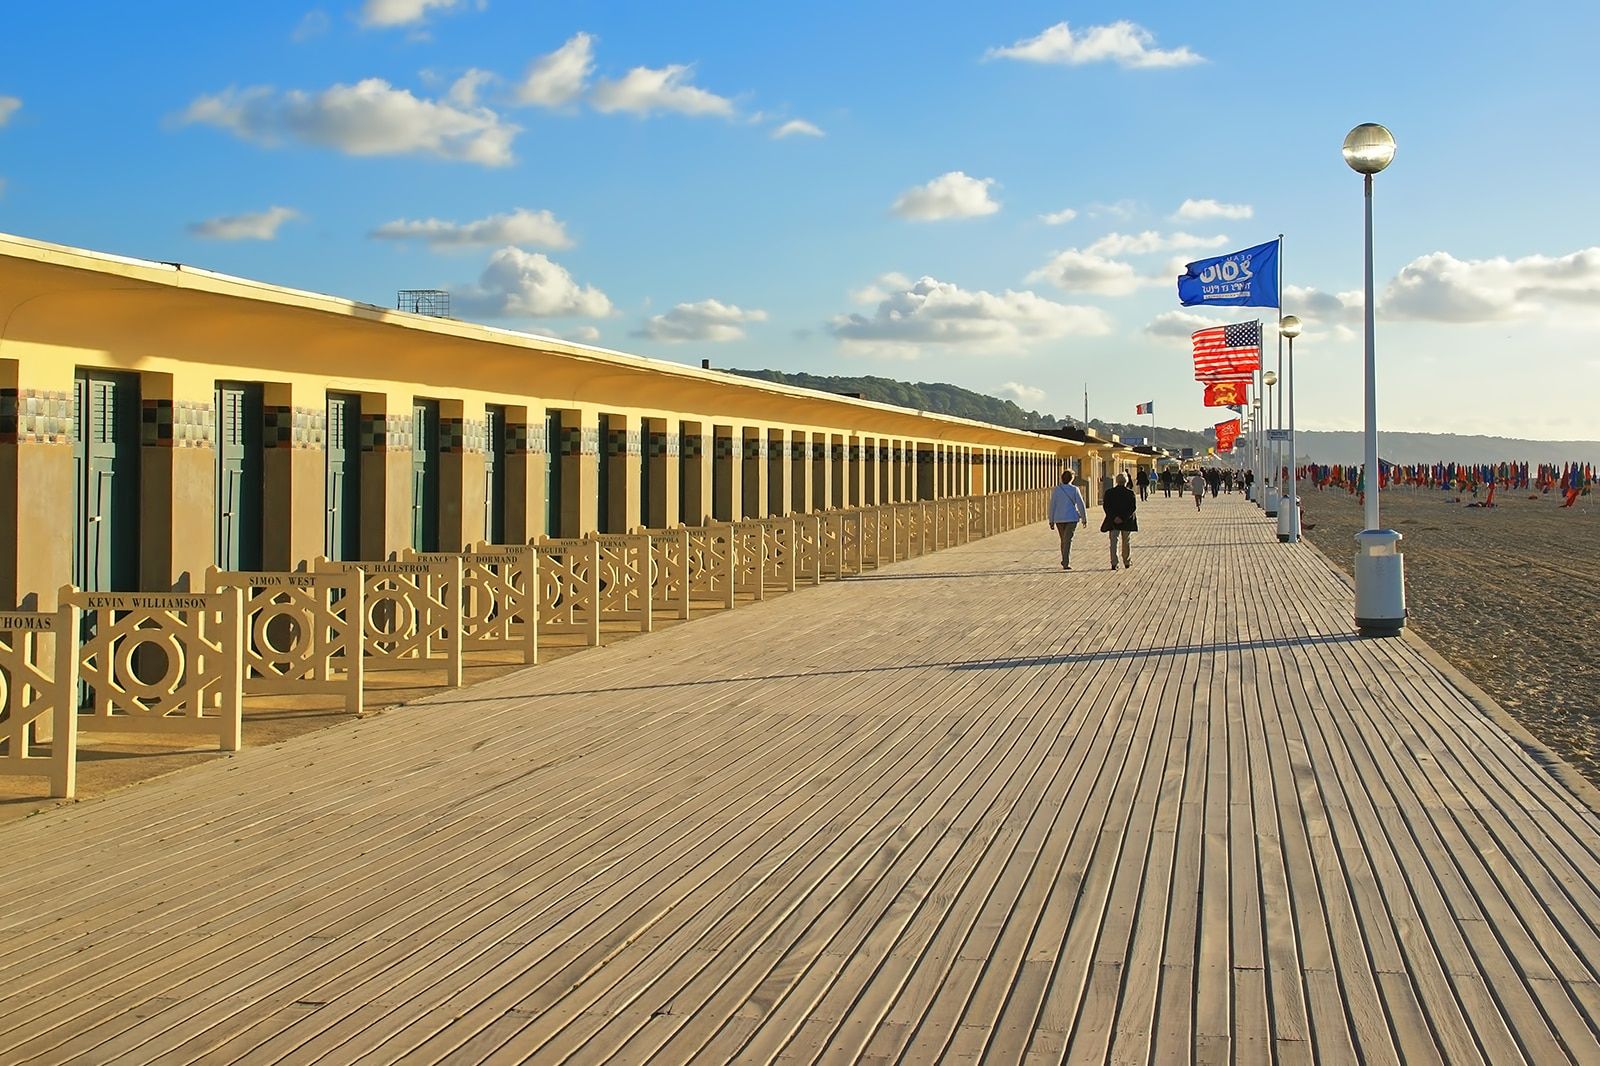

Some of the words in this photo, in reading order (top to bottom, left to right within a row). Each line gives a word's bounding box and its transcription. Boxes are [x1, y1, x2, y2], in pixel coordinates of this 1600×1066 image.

[599, 540, 627, 548] IERNAN
[476, 555, 518, 564] DORMAND
[342, 565, 370, 573] LSE
[374, 564, 430, 574] HALLSTROM
[249, 576, 282, 585] SIMON
[288, 577, 316, 586] WEST
[88, 597, 125, 608] KEVIN
[132, 597, 207, 609] WILLIAMSON
